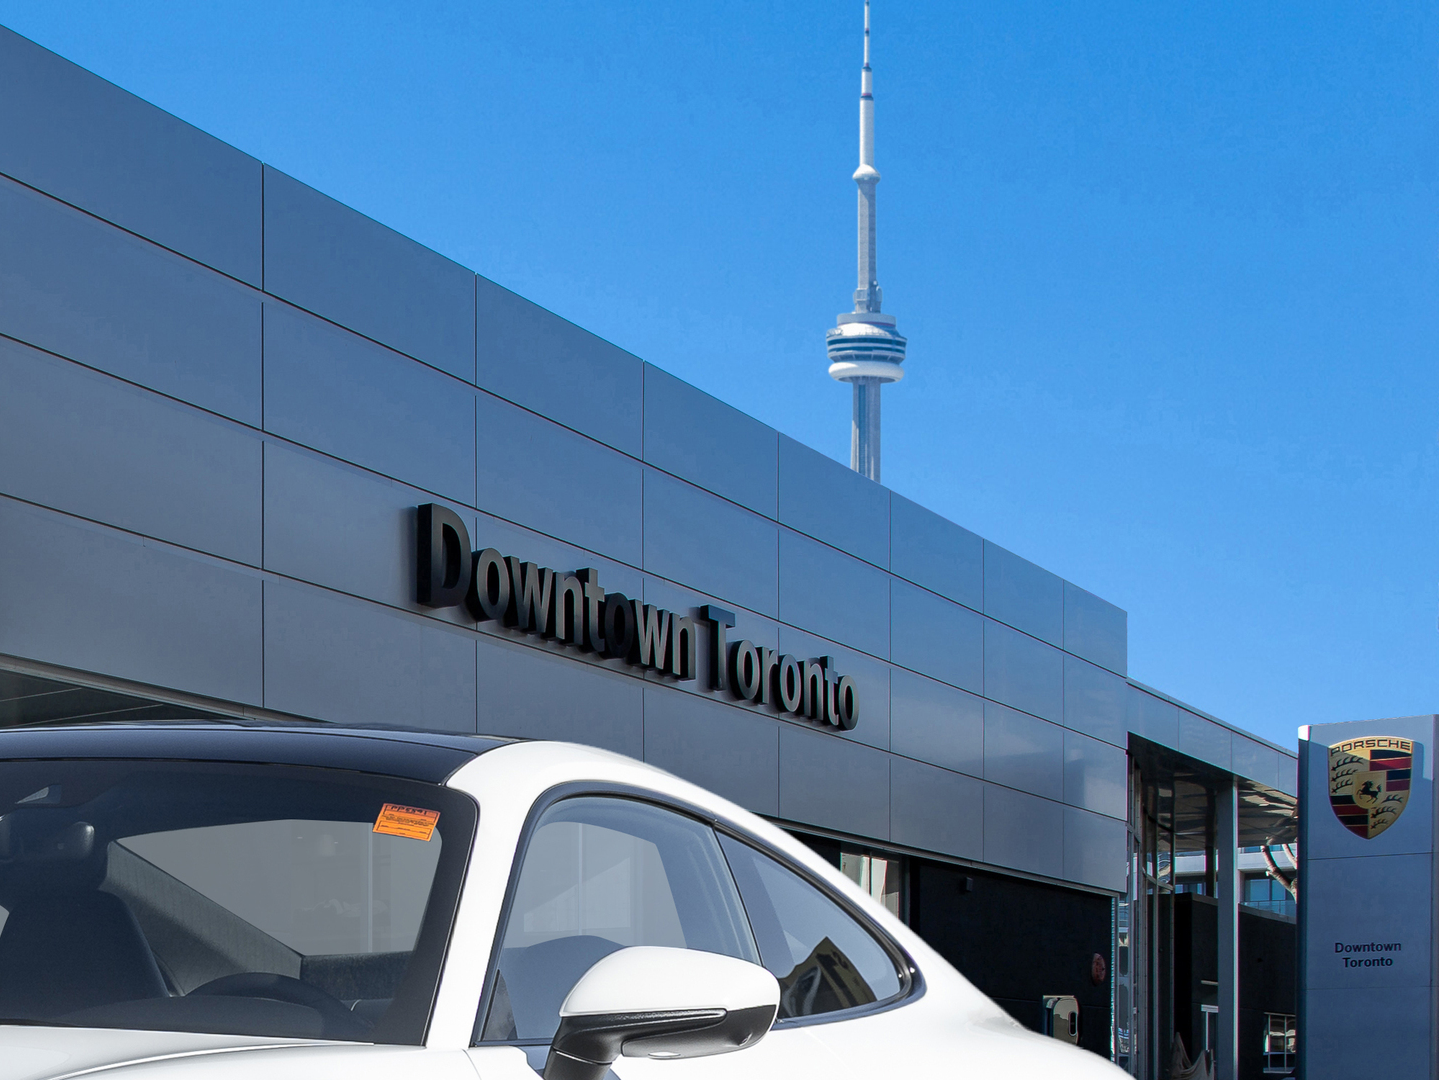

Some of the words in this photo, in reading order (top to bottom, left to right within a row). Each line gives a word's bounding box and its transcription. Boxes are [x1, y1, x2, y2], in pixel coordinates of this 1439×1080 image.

[417, 502, 696, 681] Downtown
[701, 604, 860, 731] Toronto
[1330, 739, 1411, 756] PORSCHE
[1334, 942, 1402, 953] Downtown
[1342, 957, 1394, 968] Toronto
